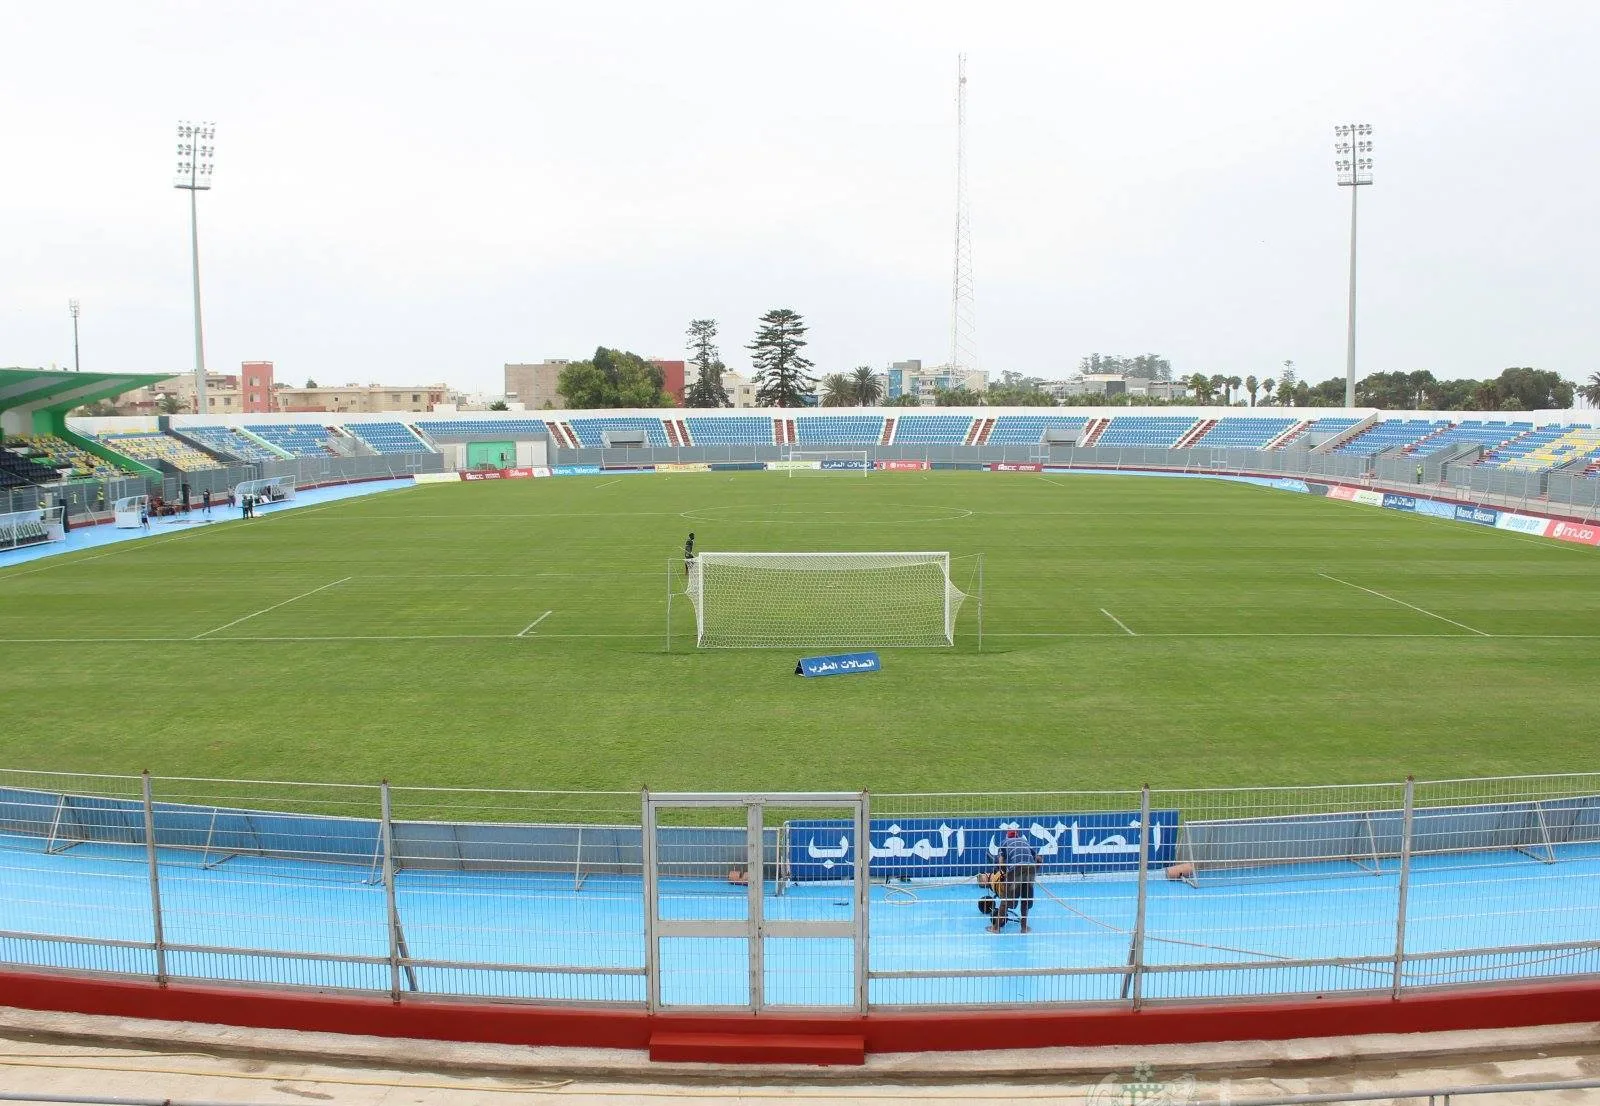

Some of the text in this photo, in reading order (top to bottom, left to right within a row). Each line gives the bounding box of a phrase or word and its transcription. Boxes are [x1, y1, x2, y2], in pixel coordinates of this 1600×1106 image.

[1456, 506, 1494, 523] Maroc Telecom
[808, 659, 875, 673] اتصالات المغرب
[988, 820, 1161, 856] اصالات
